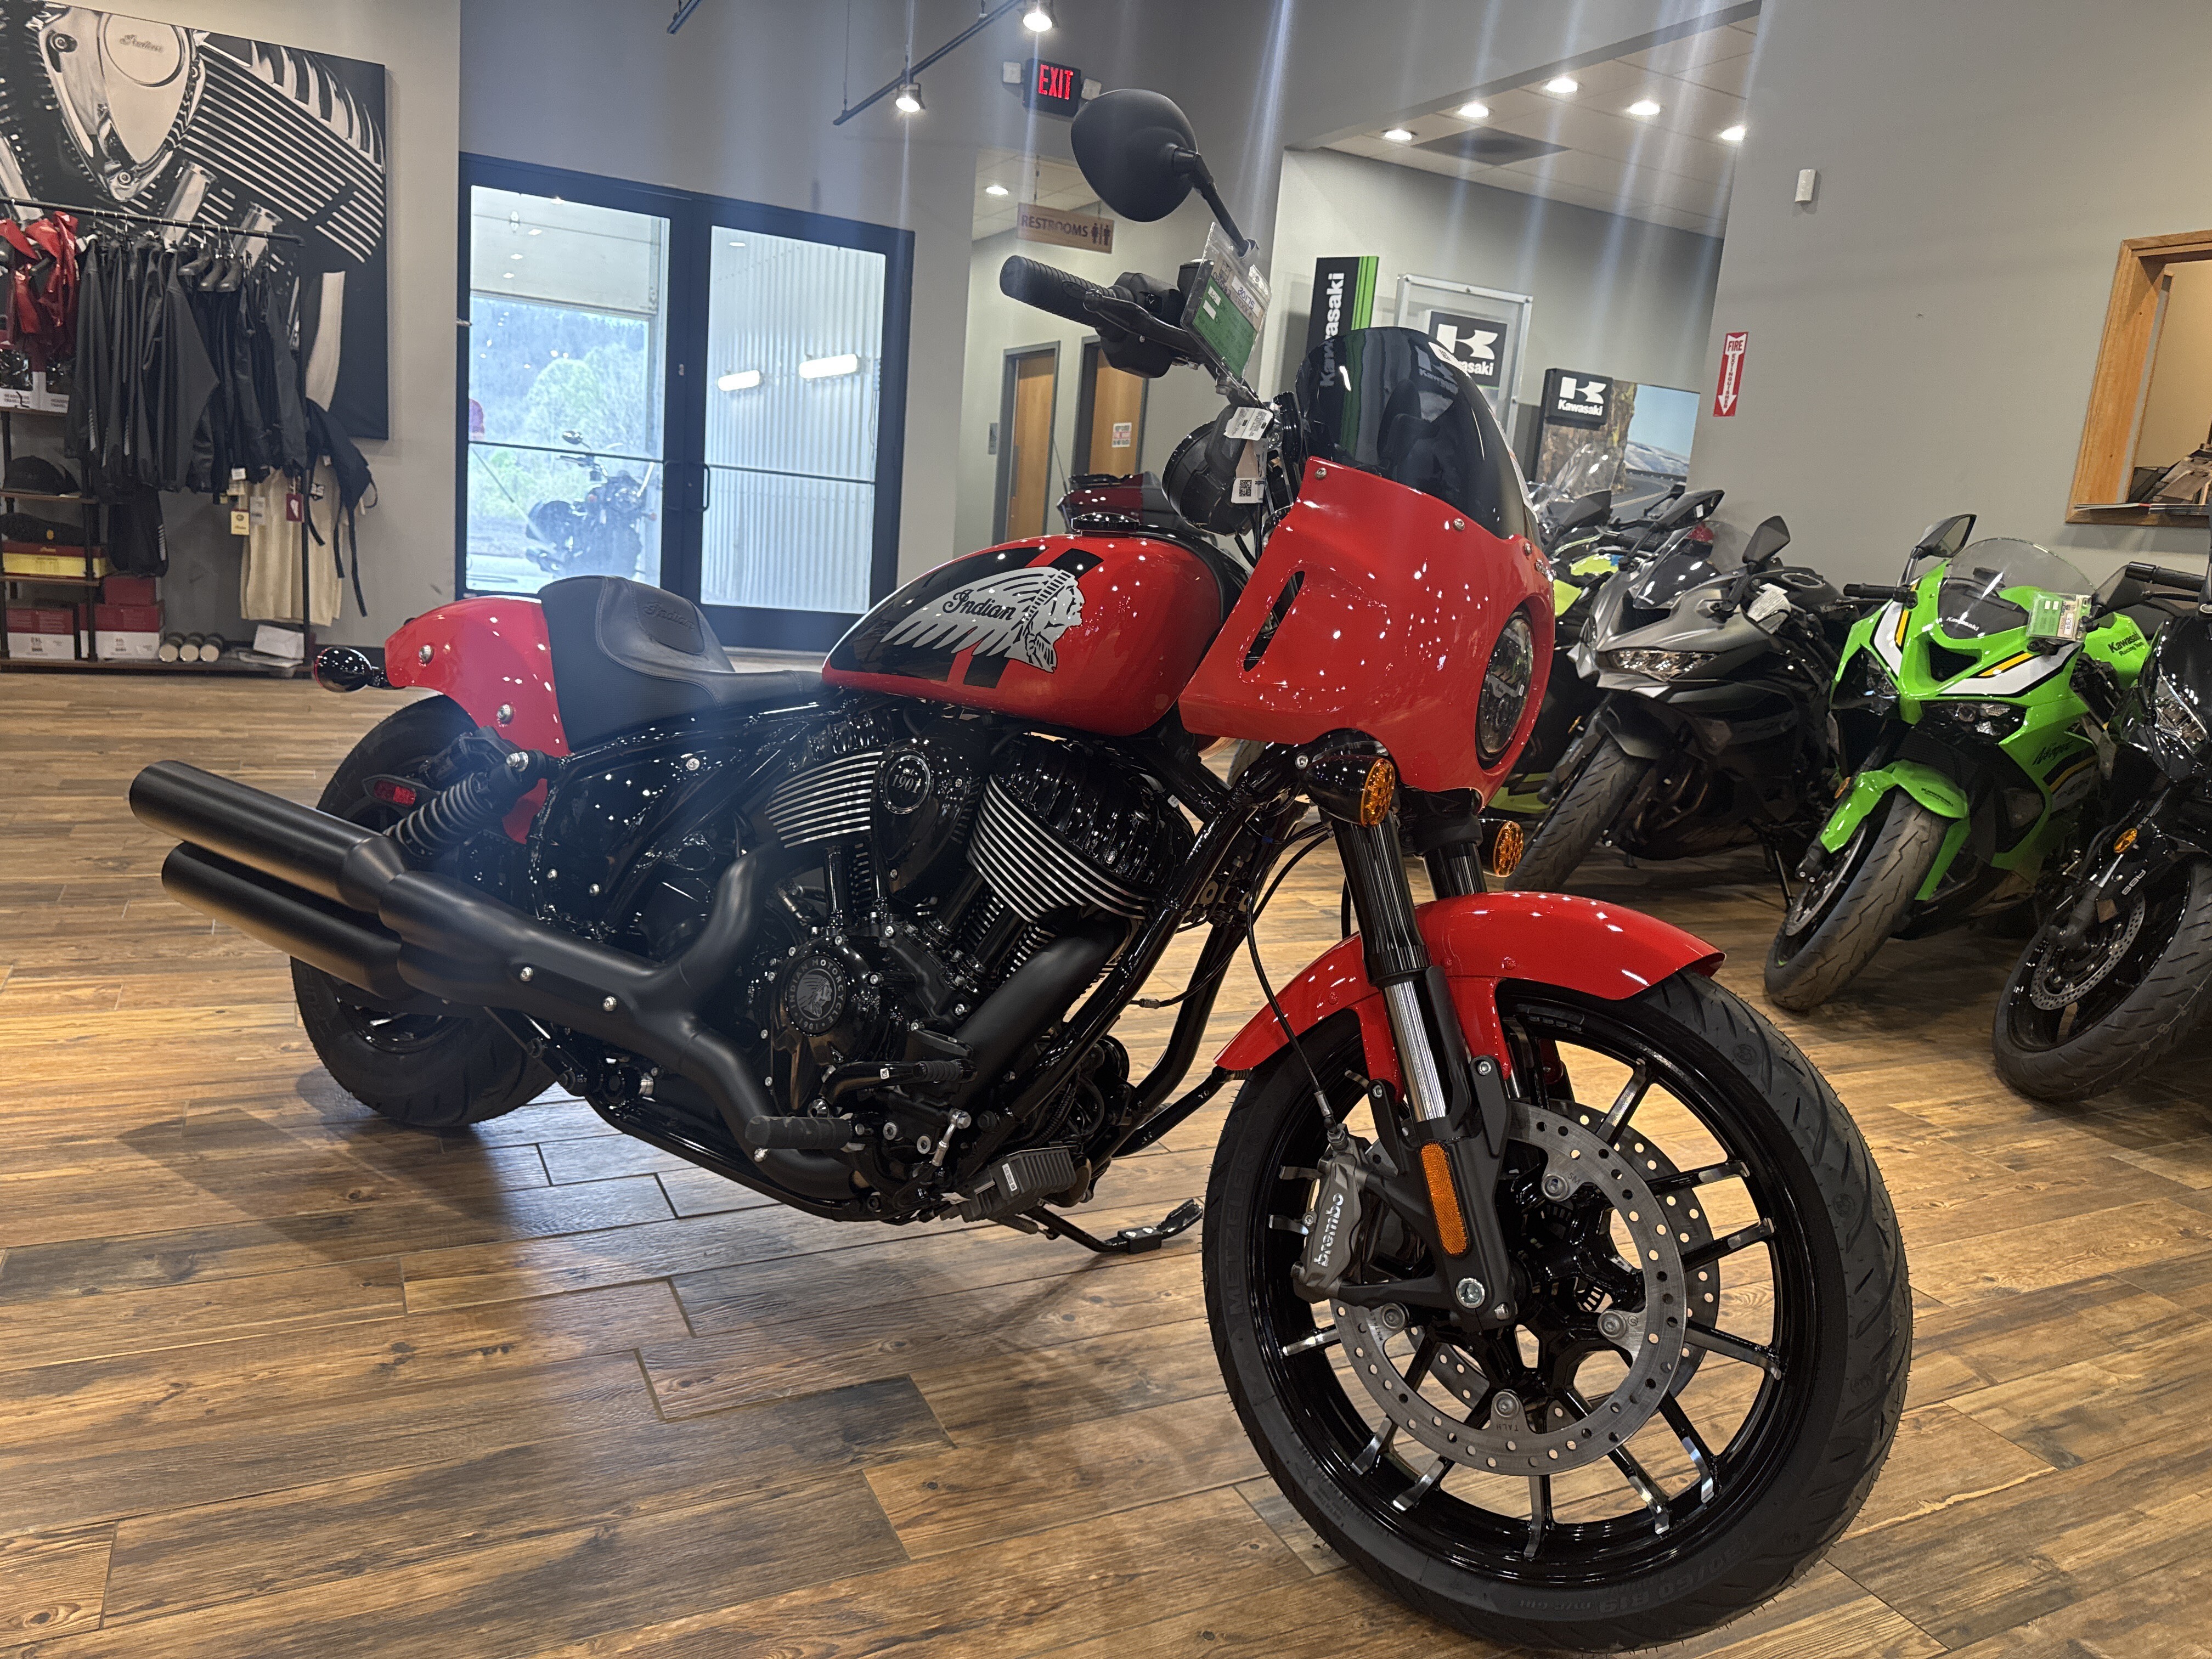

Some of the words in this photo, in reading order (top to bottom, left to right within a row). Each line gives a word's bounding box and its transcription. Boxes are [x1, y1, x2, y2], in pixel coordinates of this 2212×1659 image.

[1038, 64, 1074, 100] EXIT
[1021, 215, 1088, 238] RESTROOMS
[1728, 340, 1744, 352] FIRE
[1723, 353, 1736, 409] EXTINGUISHER
[1558, 399, 1604, 416] Kawasaki
[642, 602, 695, 630] Indian
[943, 589, 1017, 621] Indian
[2107, 631, 2142, 653] Kawasaki
[891, 774, 922, 794] 1901
[2121, 869, 2146, 895] ABS
[789, 963, 809, 1009] INDIAN
[812, 959, 844, 1024] MOTORCYCLE
[799, 1018, 819, 1030] 1901
[1224, 1151, 1256, 1316] METZELER
[1314, 1193, 1344, 1267] brembo
